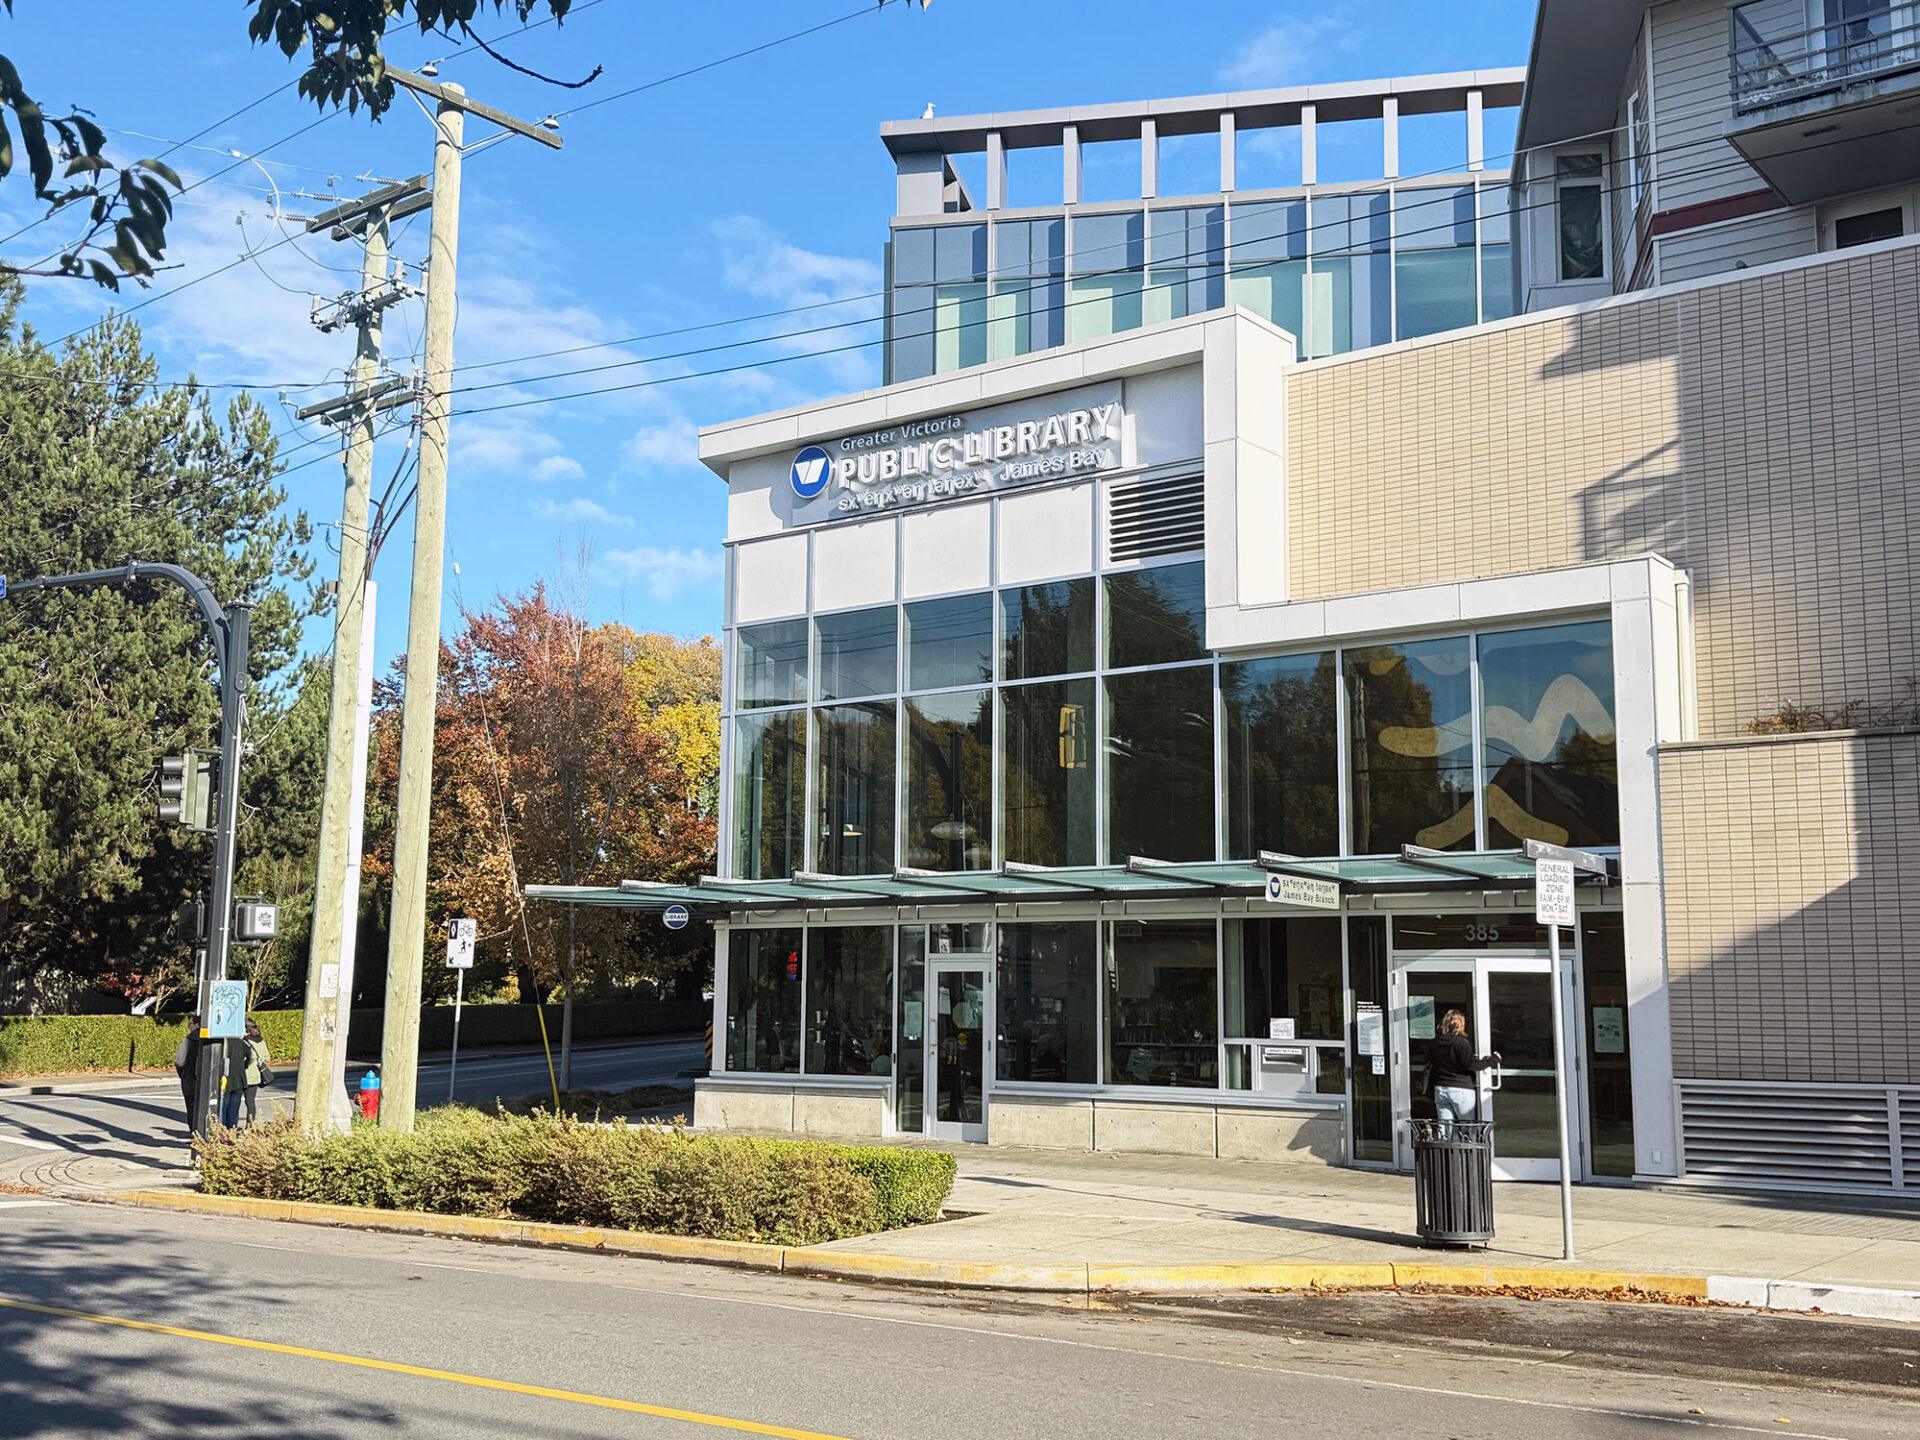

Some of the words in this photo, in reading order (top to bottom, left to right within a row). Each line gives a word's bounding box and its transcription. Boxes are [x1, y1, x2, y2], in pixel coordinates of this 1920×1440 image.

[841, 431, 895, 451] Greater
[901, 416, 961, 438] Victoria
[839, 438, 952, 488] PUBLIC
[964, 402, 1117, 464] LIBRARY
[1001, 458, 1063, 480] James
[1070, 448, 1106, 469] Bay
[1540, 864, 1571, 873] GENERAL
[1540, 873, 1570, 884] LOADING
[1545, 884, 1564, 893] ZONE
[1283, 890, 1302, 900] James
[1303, 892, 1314, 903] Bay
[1315, 893, 1335, 905] Branch
[1465, 924, 1499, 941] 385
